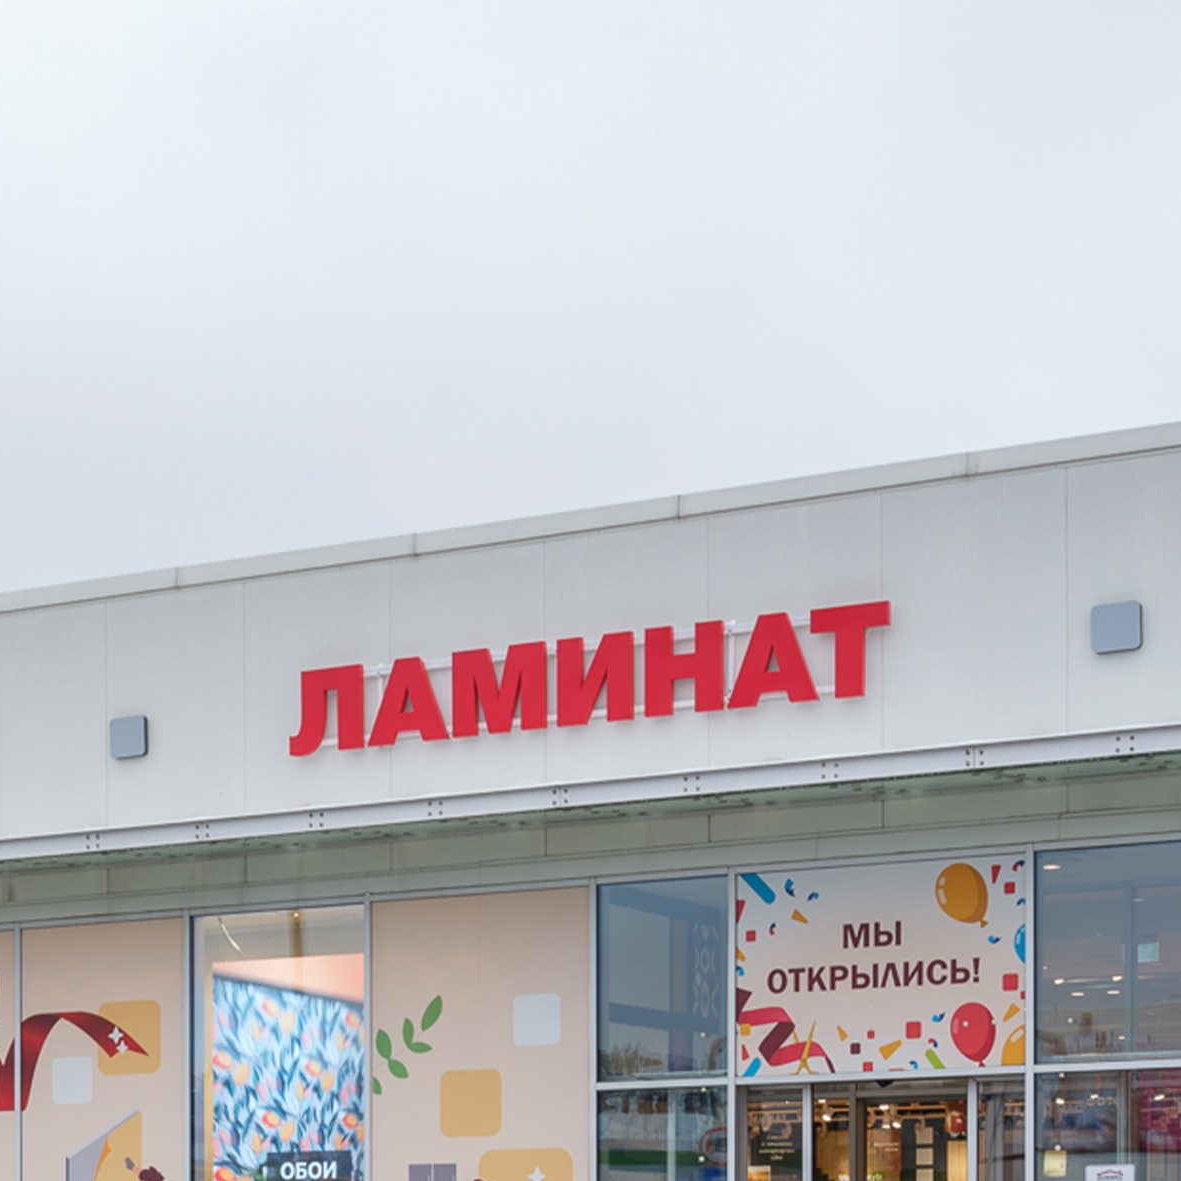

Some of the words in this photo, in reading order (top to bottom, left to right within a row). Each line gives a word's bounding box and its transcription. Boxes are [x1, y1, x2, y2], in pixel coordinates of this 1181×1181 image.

[290, 600, 891, 757] ЛАМИНАТ
[842, 920, 902, 950] МЫ
[766, 957, 981, 995] ОТКРЫЛИСЬ!
[280, 1161, 337, 1180] ОБОИ
